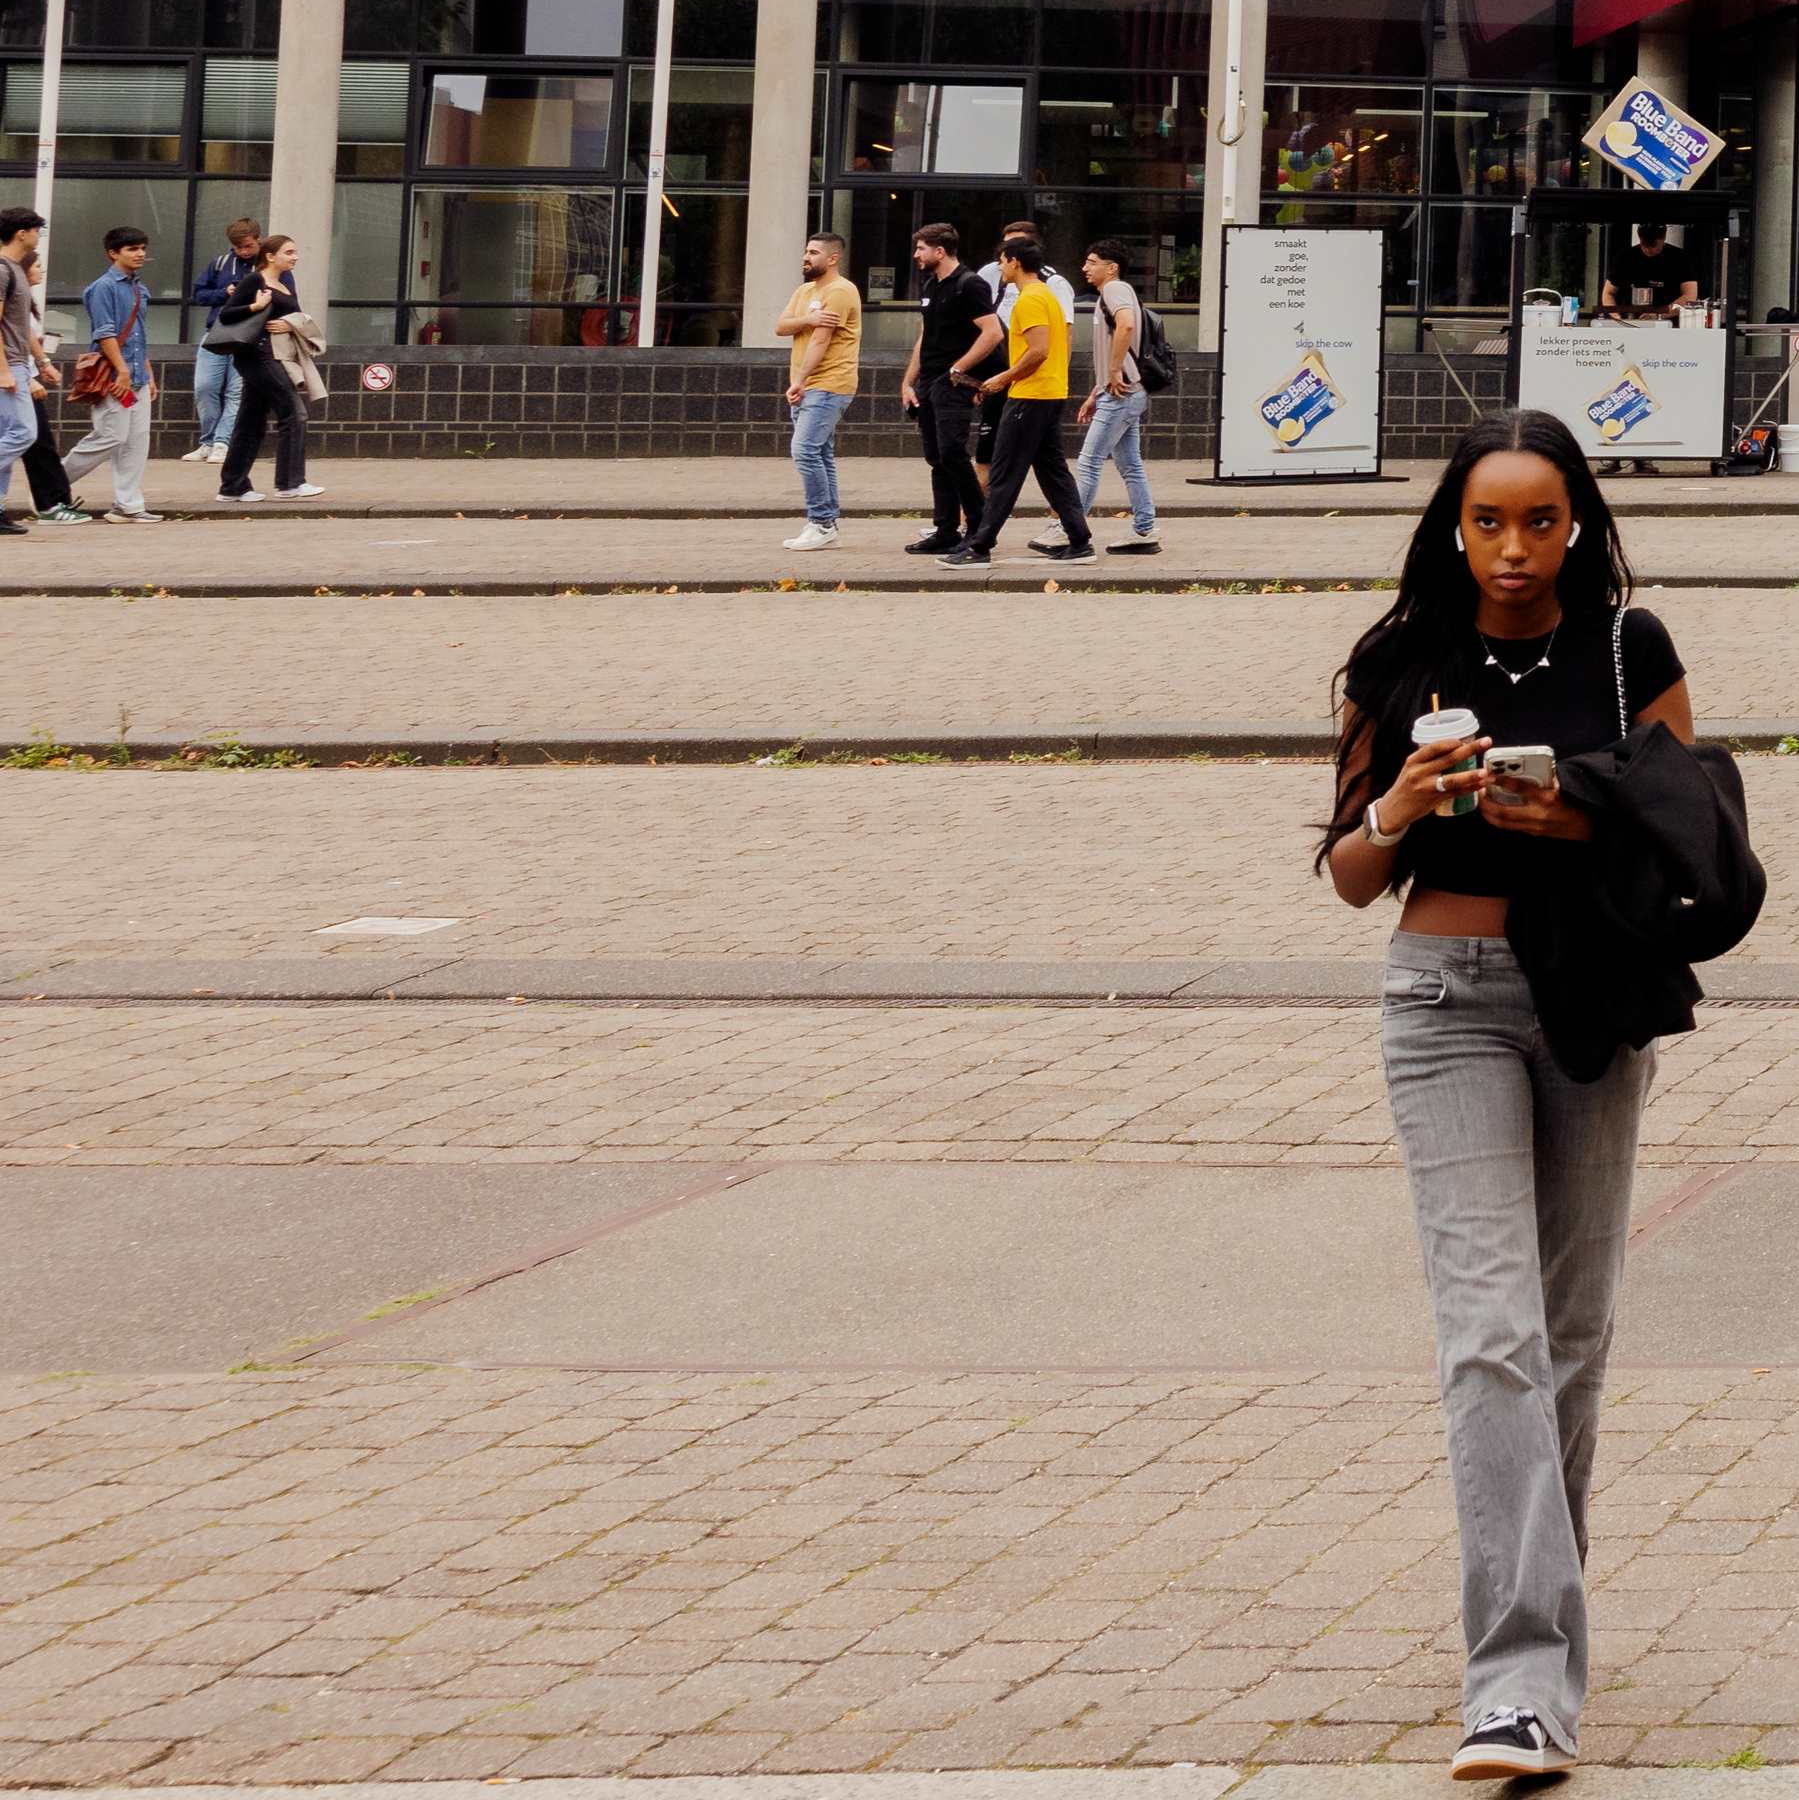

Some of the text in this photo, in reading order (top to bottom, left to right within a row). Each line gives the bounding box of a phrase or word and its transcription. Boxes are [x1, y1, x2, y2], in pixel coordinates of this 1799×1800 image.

[1630, 93, 1709, 158] Blue Band
[1274, 239, 1307, 248] smaakt
[1288, 253, 1309, 262] goe,
[1274, 263, 1307, 272] zonder
[1260, 275, 1306, 286] dat gedoe
[1287, 288, 1305, 296] met
[1288, 299, 1305, 308] koe
[1295, 338, 1353, 349] skip the cow
[1540, 337, 1612, 347] lekker proeven
[1535, 348, 1570, 356] zonder
[1572, 348, 1590, 356] iets
[1576, 359, 1611, 367] hoeven
[1642, 359, 1660, 368] skip
[1662, 359, 1677, 367] the
[1262, 395, 1291, 419] Blue
[1287, 368, 1319, 396] Band
[1588, 399, 1614, 420] Blue
[1610, 380, 1638, 404] Band
